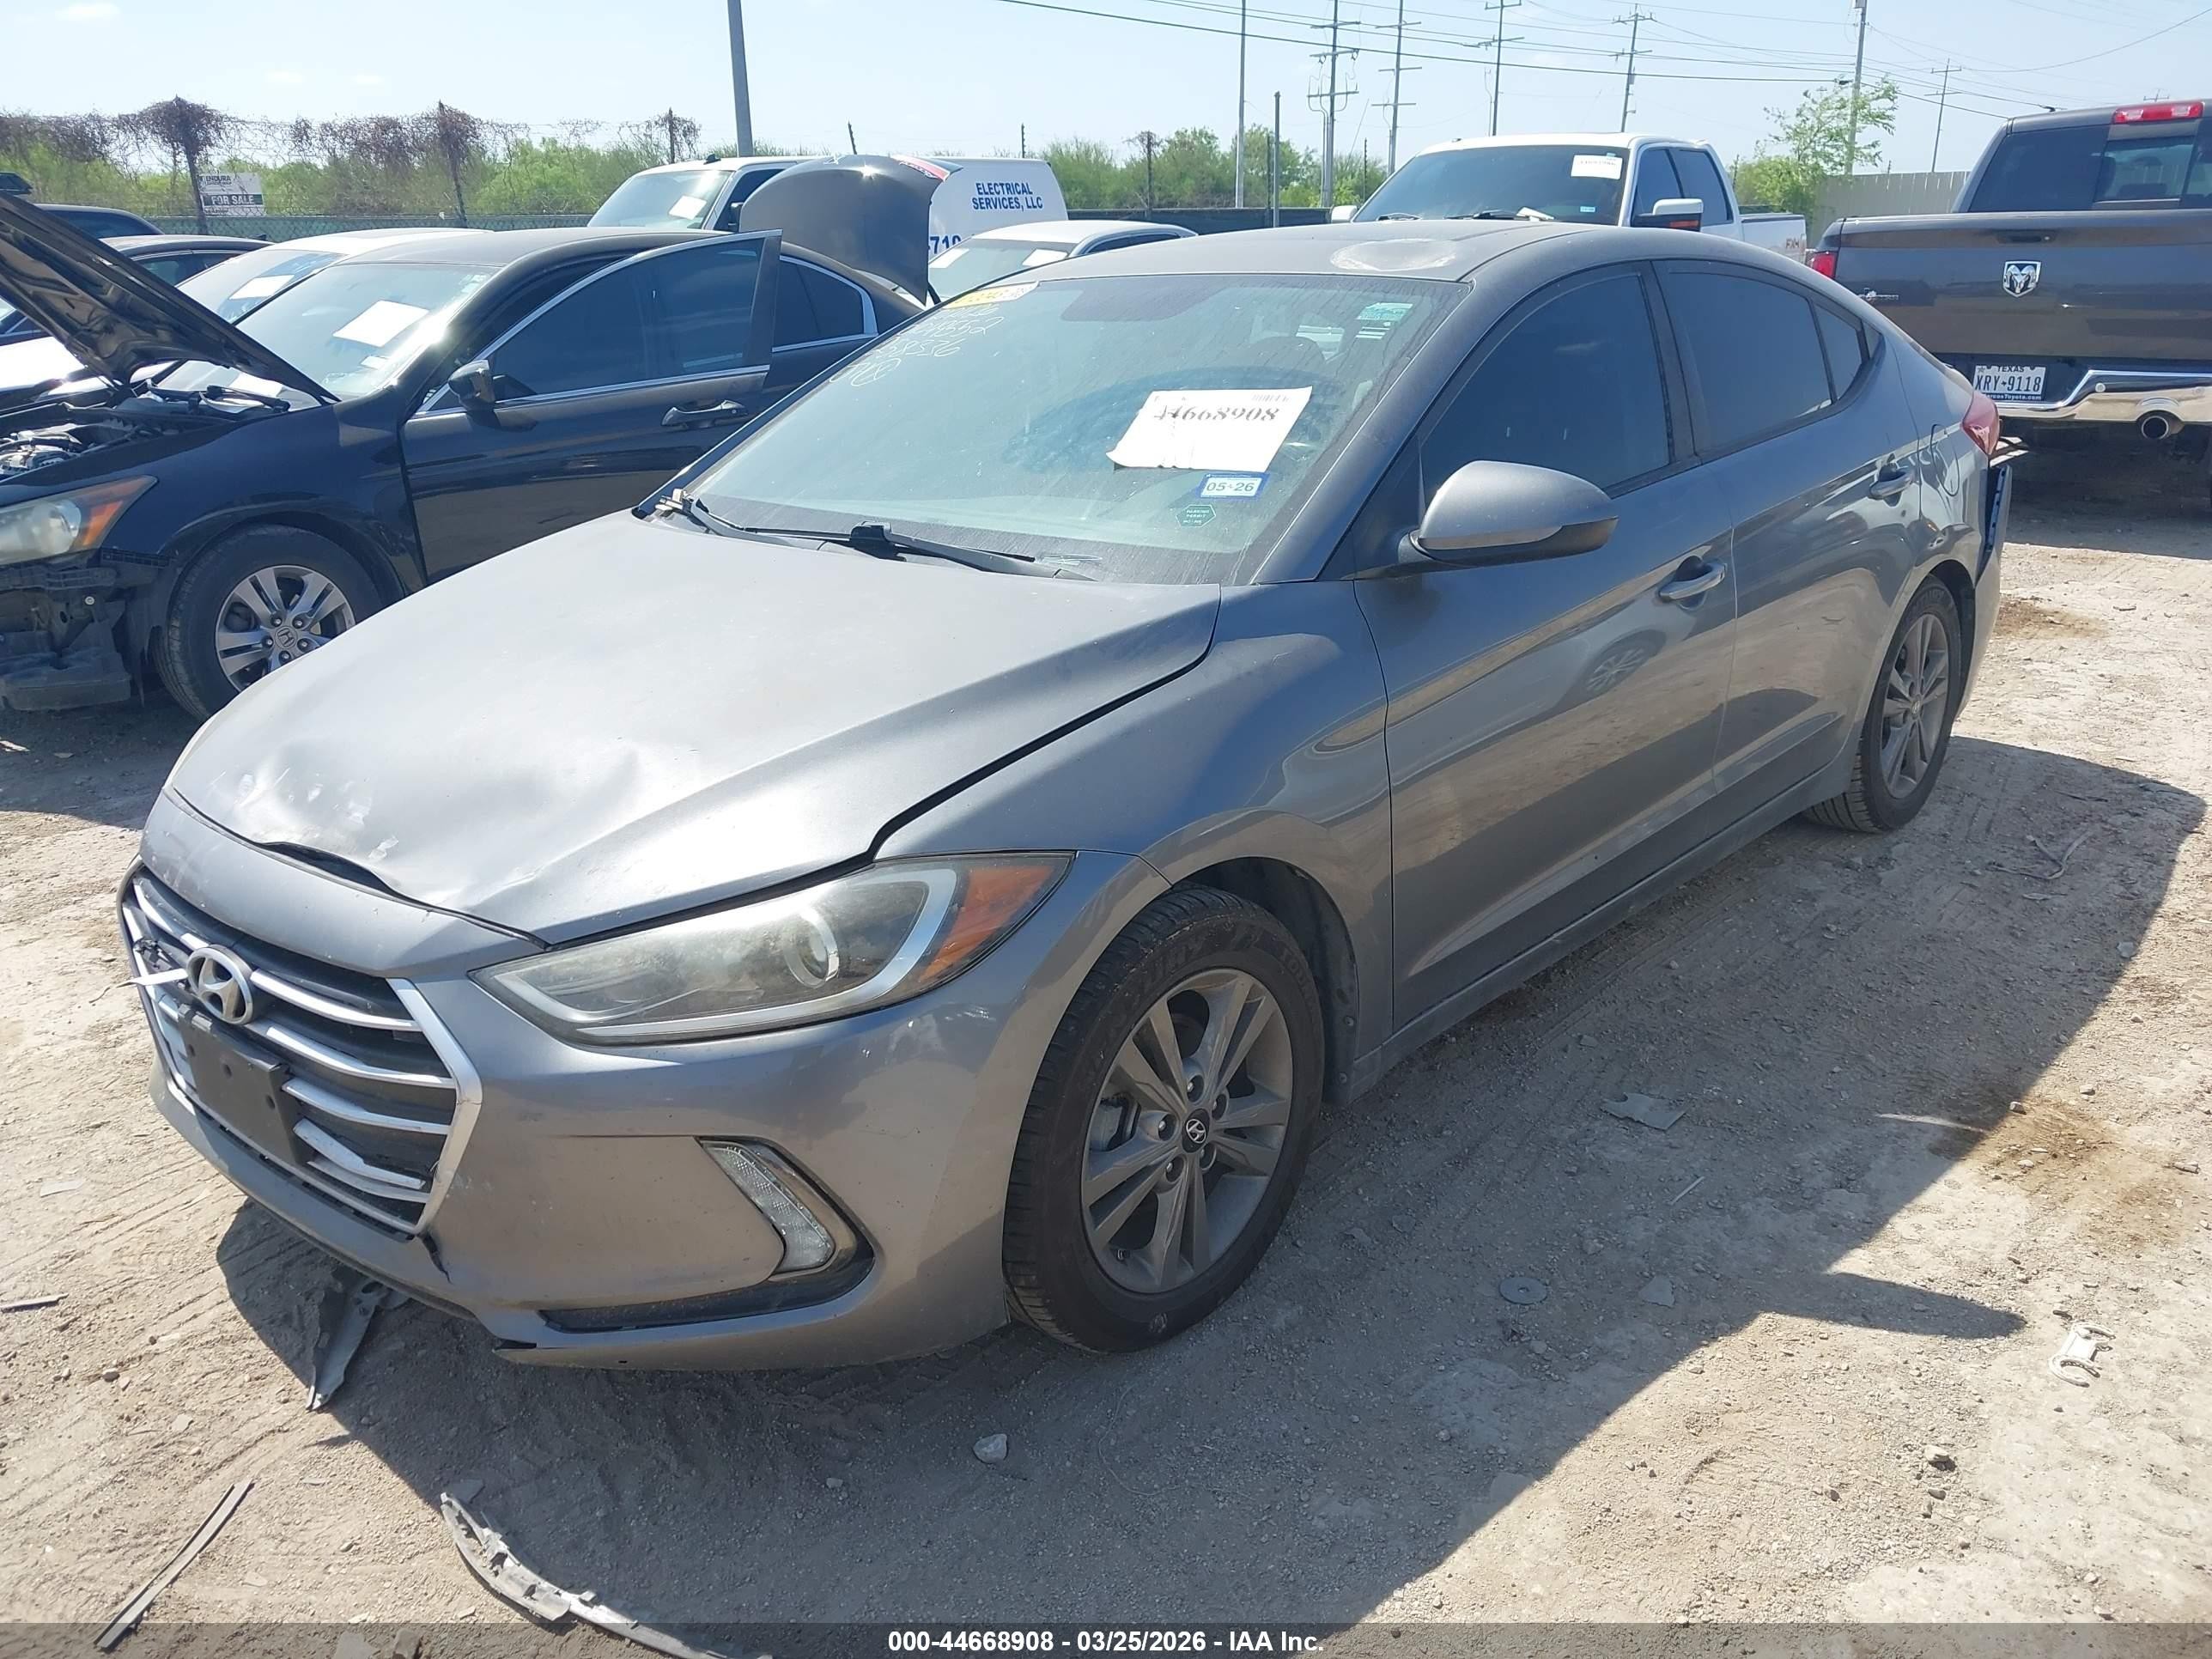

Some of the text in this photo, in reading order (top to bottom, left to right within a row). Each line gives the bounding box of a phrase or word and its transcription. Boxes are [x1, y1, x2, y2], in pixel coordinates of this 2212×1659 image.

[975, 182, 1033, 196] ELECTRICAL
[211, 195, 255, 205] FOR SALE
[972, 197, 1043, 212] SERVICES, LLC
[1153, 404, 1279, 422] 44668908
